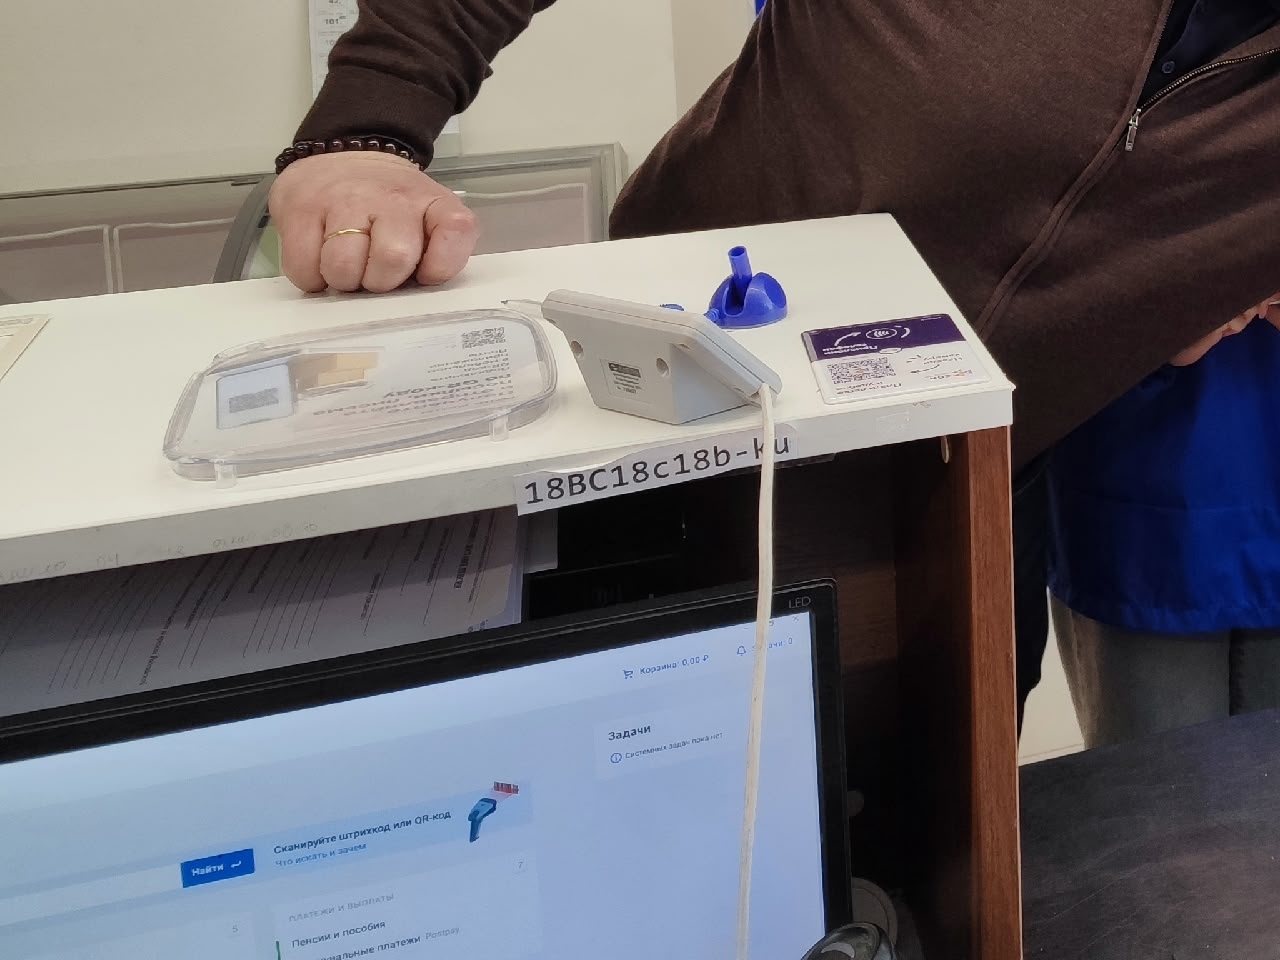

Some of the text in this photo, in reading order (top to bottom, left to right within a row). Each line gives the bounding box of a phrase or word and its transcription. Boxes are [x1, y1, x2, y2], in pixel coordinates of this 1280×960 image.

[788, 596, 812, 610] LED
[608, 725, 651, 741] Задачи
[273, 810, 451, 854] Сканируйте штрихкод или QR-код
[192, 863, 224, 877] Найти
[289, 893, 395, 922] ПЛАТЕЖИ И ВЫПЛАТЫ
[291, 921, 386, 949] Пенсии и пособия
[377, 936, 421, 952] платежи
